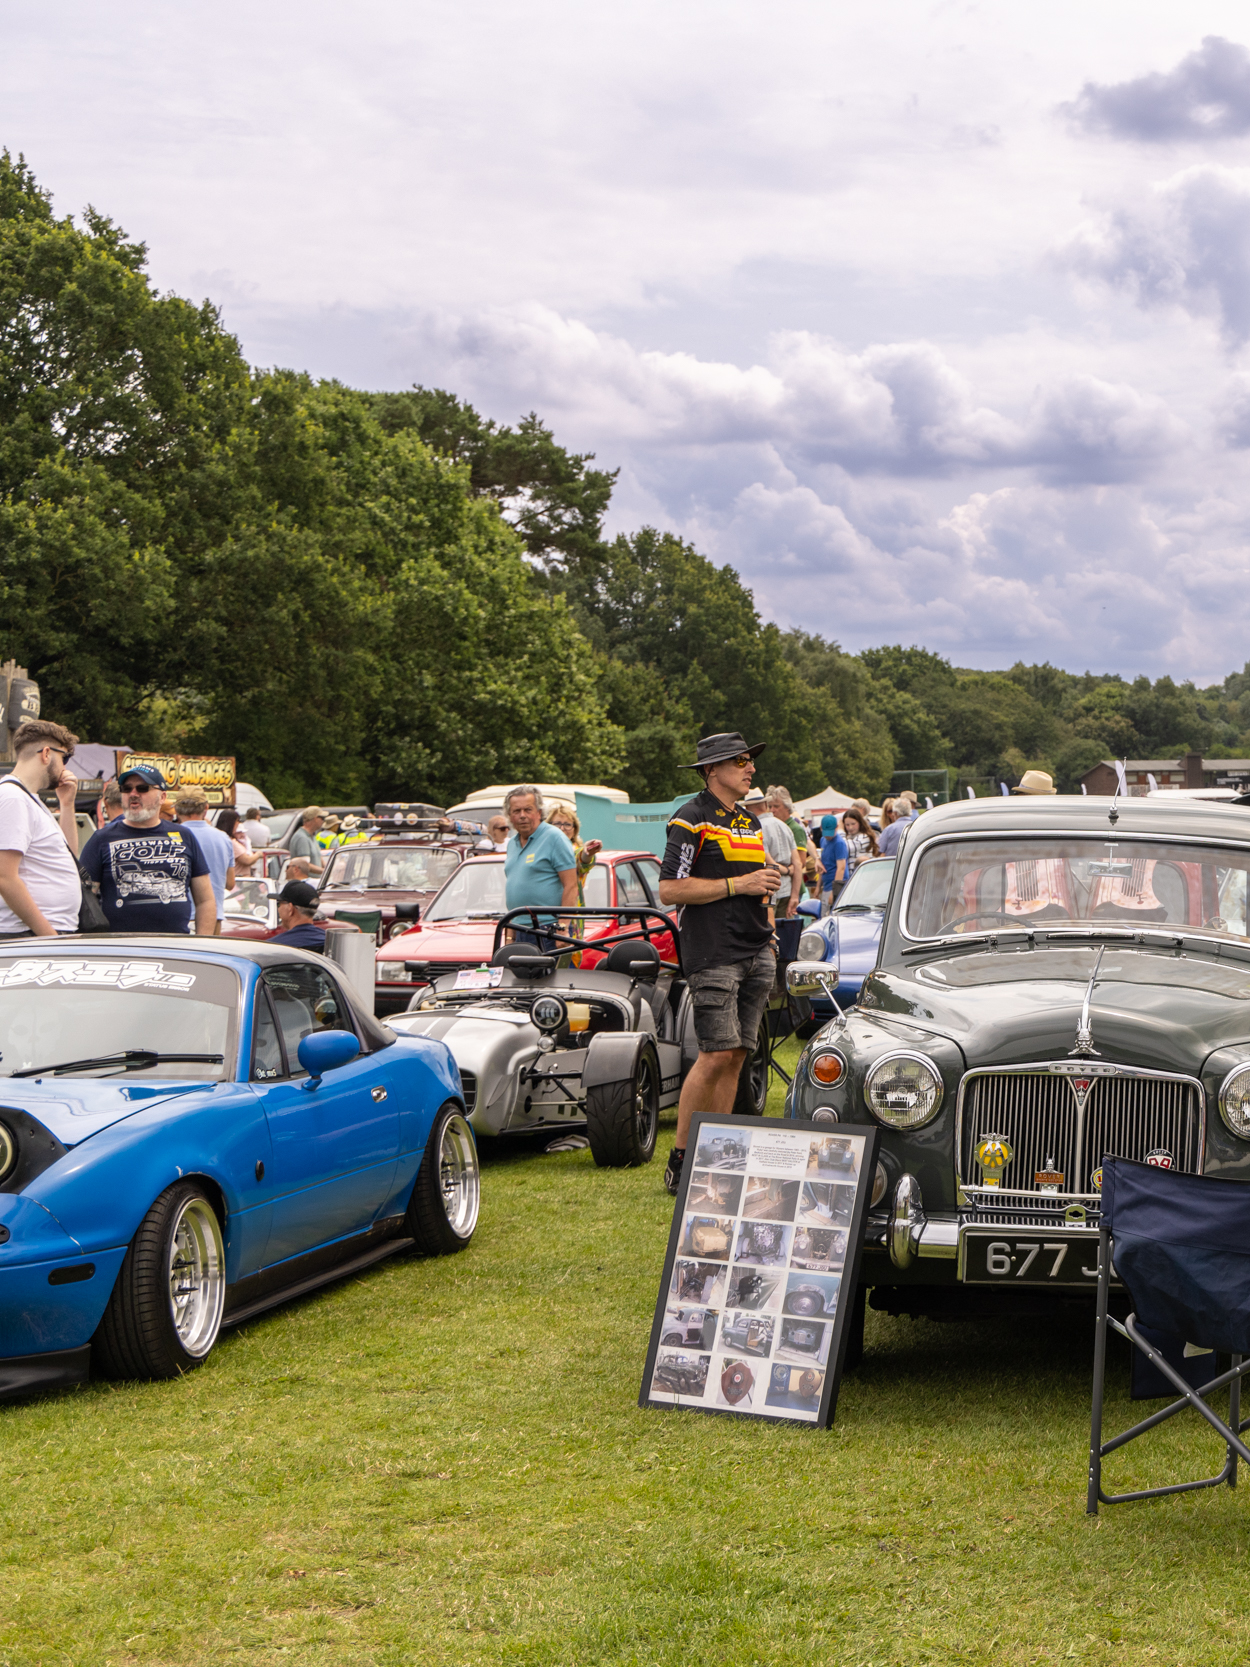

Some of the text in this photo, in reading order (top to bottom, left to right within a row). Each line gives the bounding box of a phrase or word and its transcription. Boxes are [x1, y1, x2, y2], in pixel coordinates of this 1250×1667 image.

[178, 759, 232, 786] SAUSAGES
[114, 845, 186, 860] GOLF
[1054, 1065, 1111, 1073] ROVER
[986, 1242, 1068, 1277] 677
